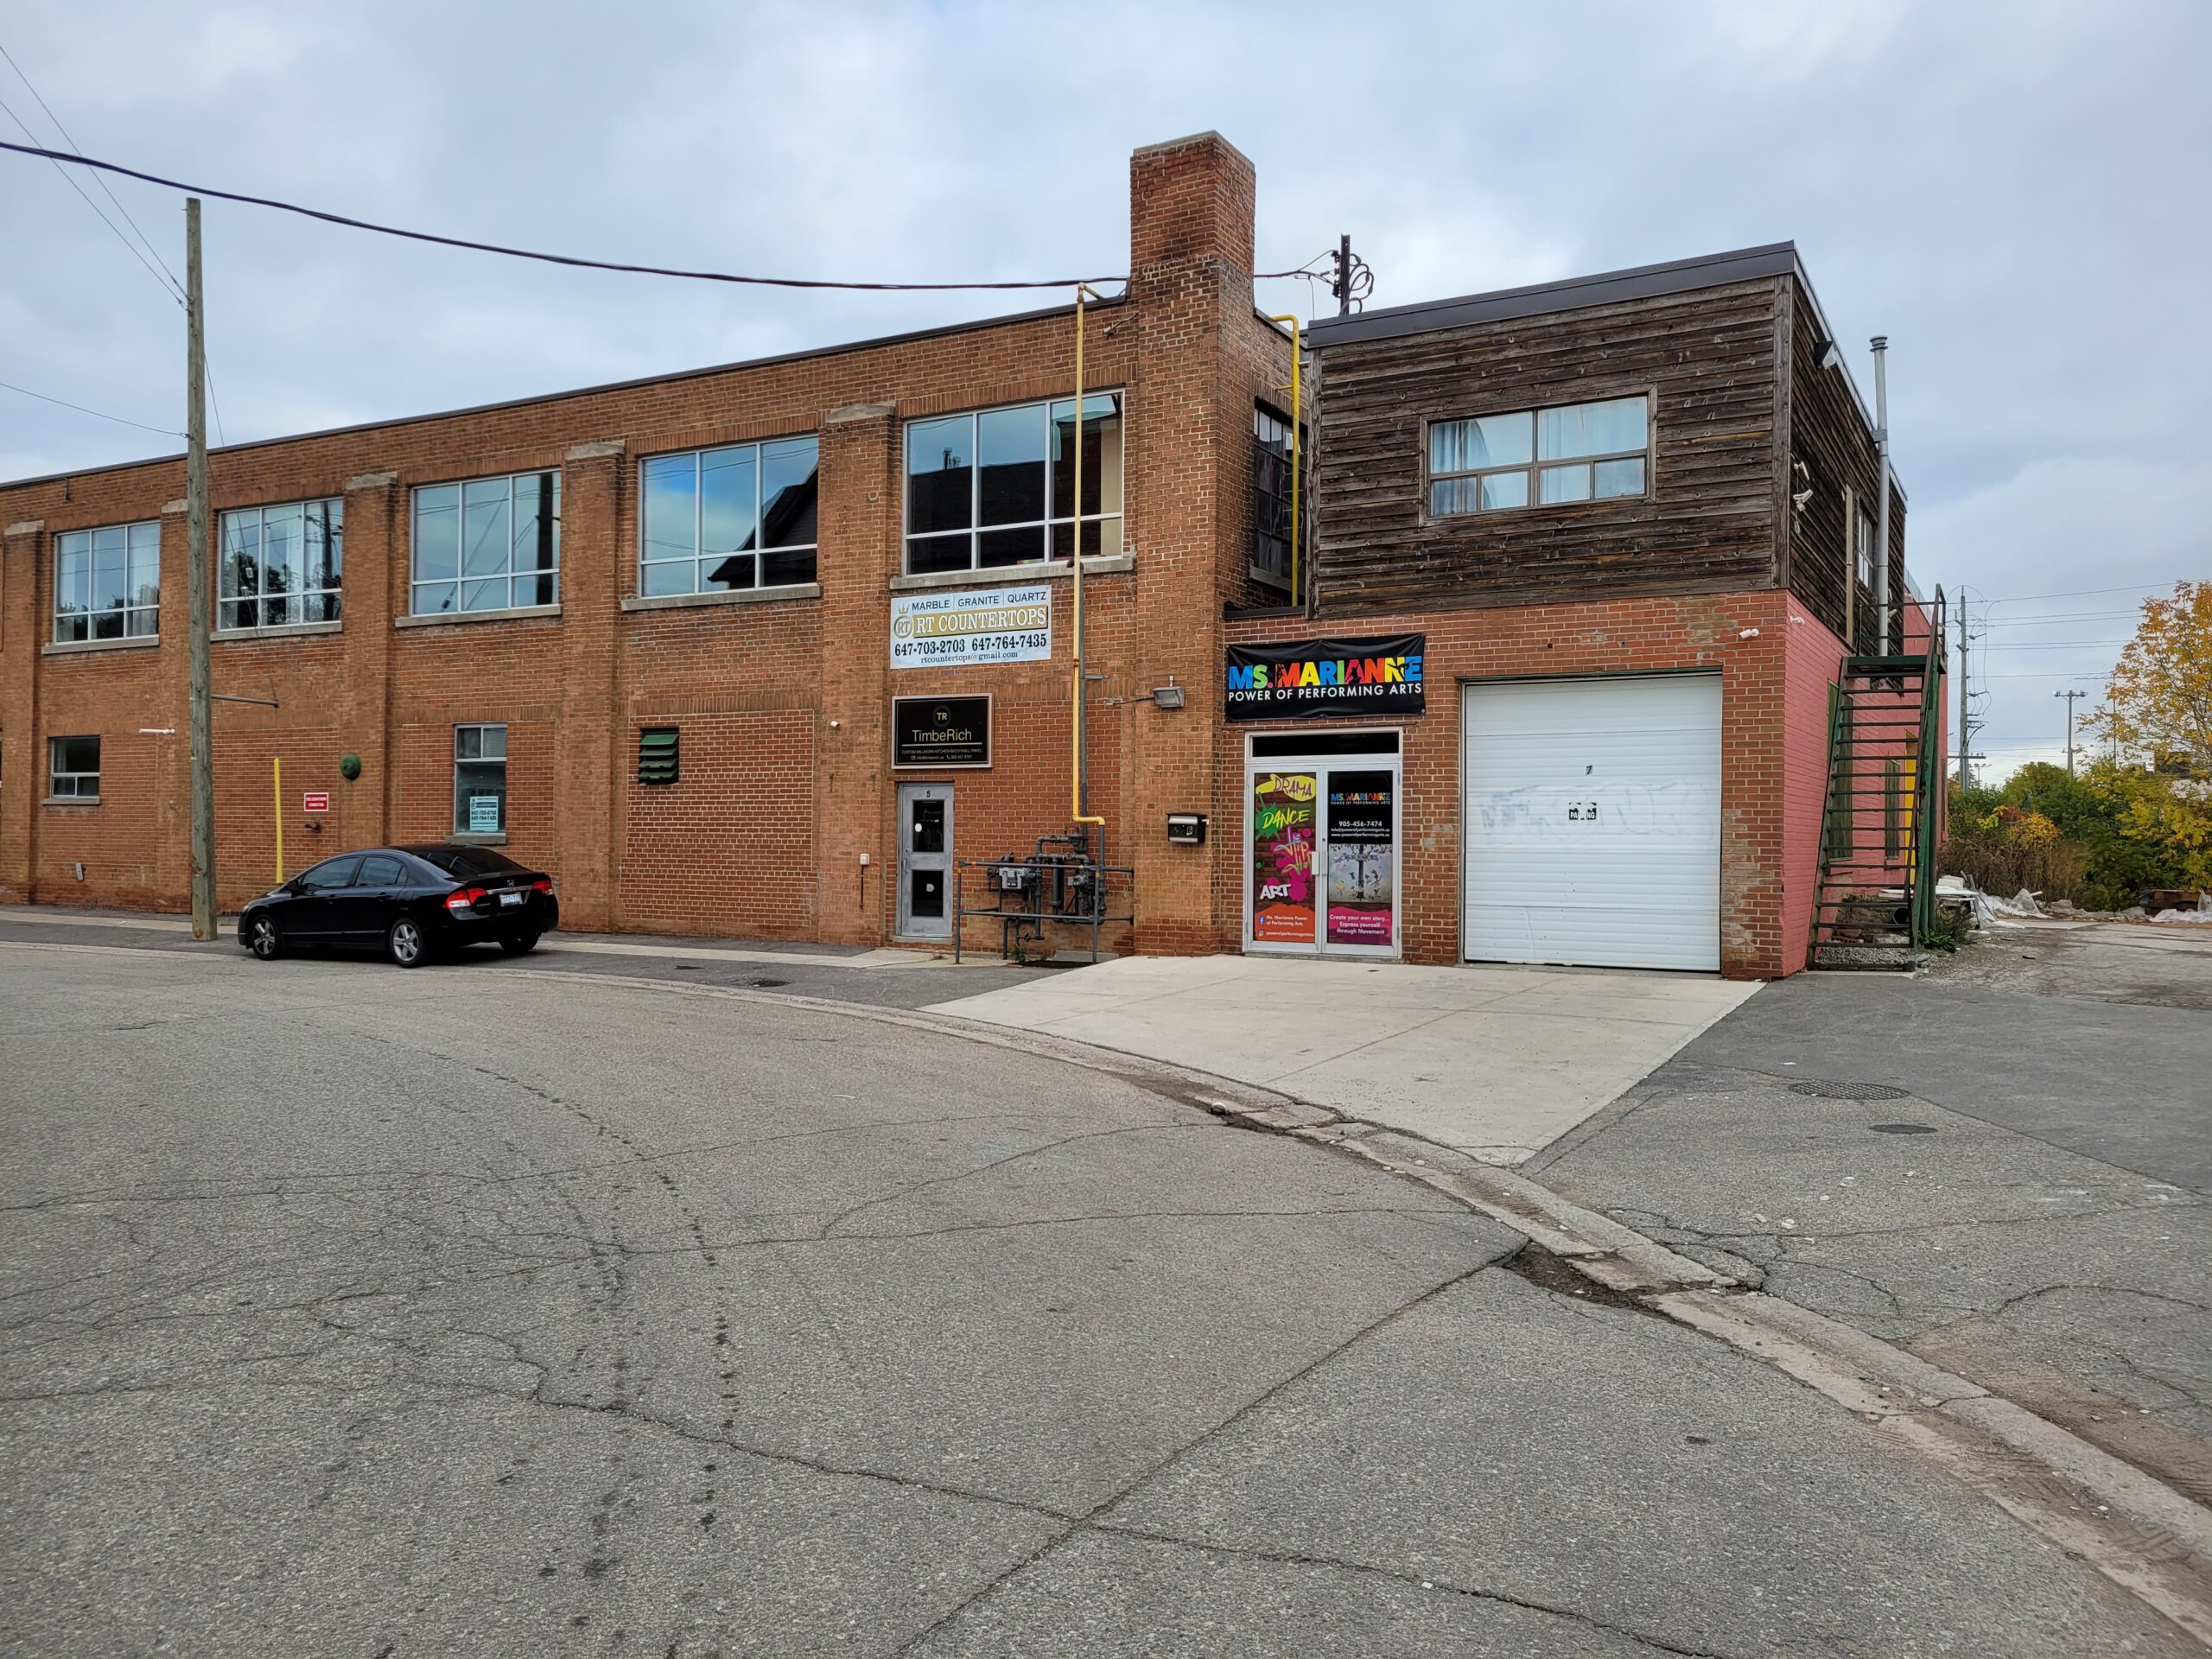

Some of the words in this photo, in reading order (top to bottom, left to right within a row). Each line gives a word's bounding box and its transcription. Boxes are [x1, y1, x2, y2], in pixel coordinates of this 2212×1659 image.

[912, 600, 950, 612] MARBLE
[957, 595, 1000, 607] GRANITE
[1007, 591, 1047, 603] QUARTZ
[897, 620, 911, 634] RT
[916, 617, 935, 634] RT
[938, 607, 1047, 632] COUNTERTOPS
[894, 639, 965, 657] 647-703-2703
[971, 632, 1047, 652] 647-764-7435
[920, 651, 1018, 664] rtcountertops@gmail.com
[1229, 664, 1274, 690] MS.
[1274, 656, 1422, 688] MARIANNE
[1228, 691, 1271, 702] POWER
[1276, 690, 1294, 701] OF
[1298, 685, 1383, 699] PERFORMING
[1389, 683, 1422, 695] ARTS
[936, 712, 948, 721] TR
[912, 728, 972, 742] TimbeRich
[1586, 765, 1592, 775] 7
[1273, 776, 1313, 797] DRAMA
[1345, 792, 1391, 801] MARIANNE
[1262, 807, 1311, 829] DANCE
[1260, 884, 1292, 899] ART
